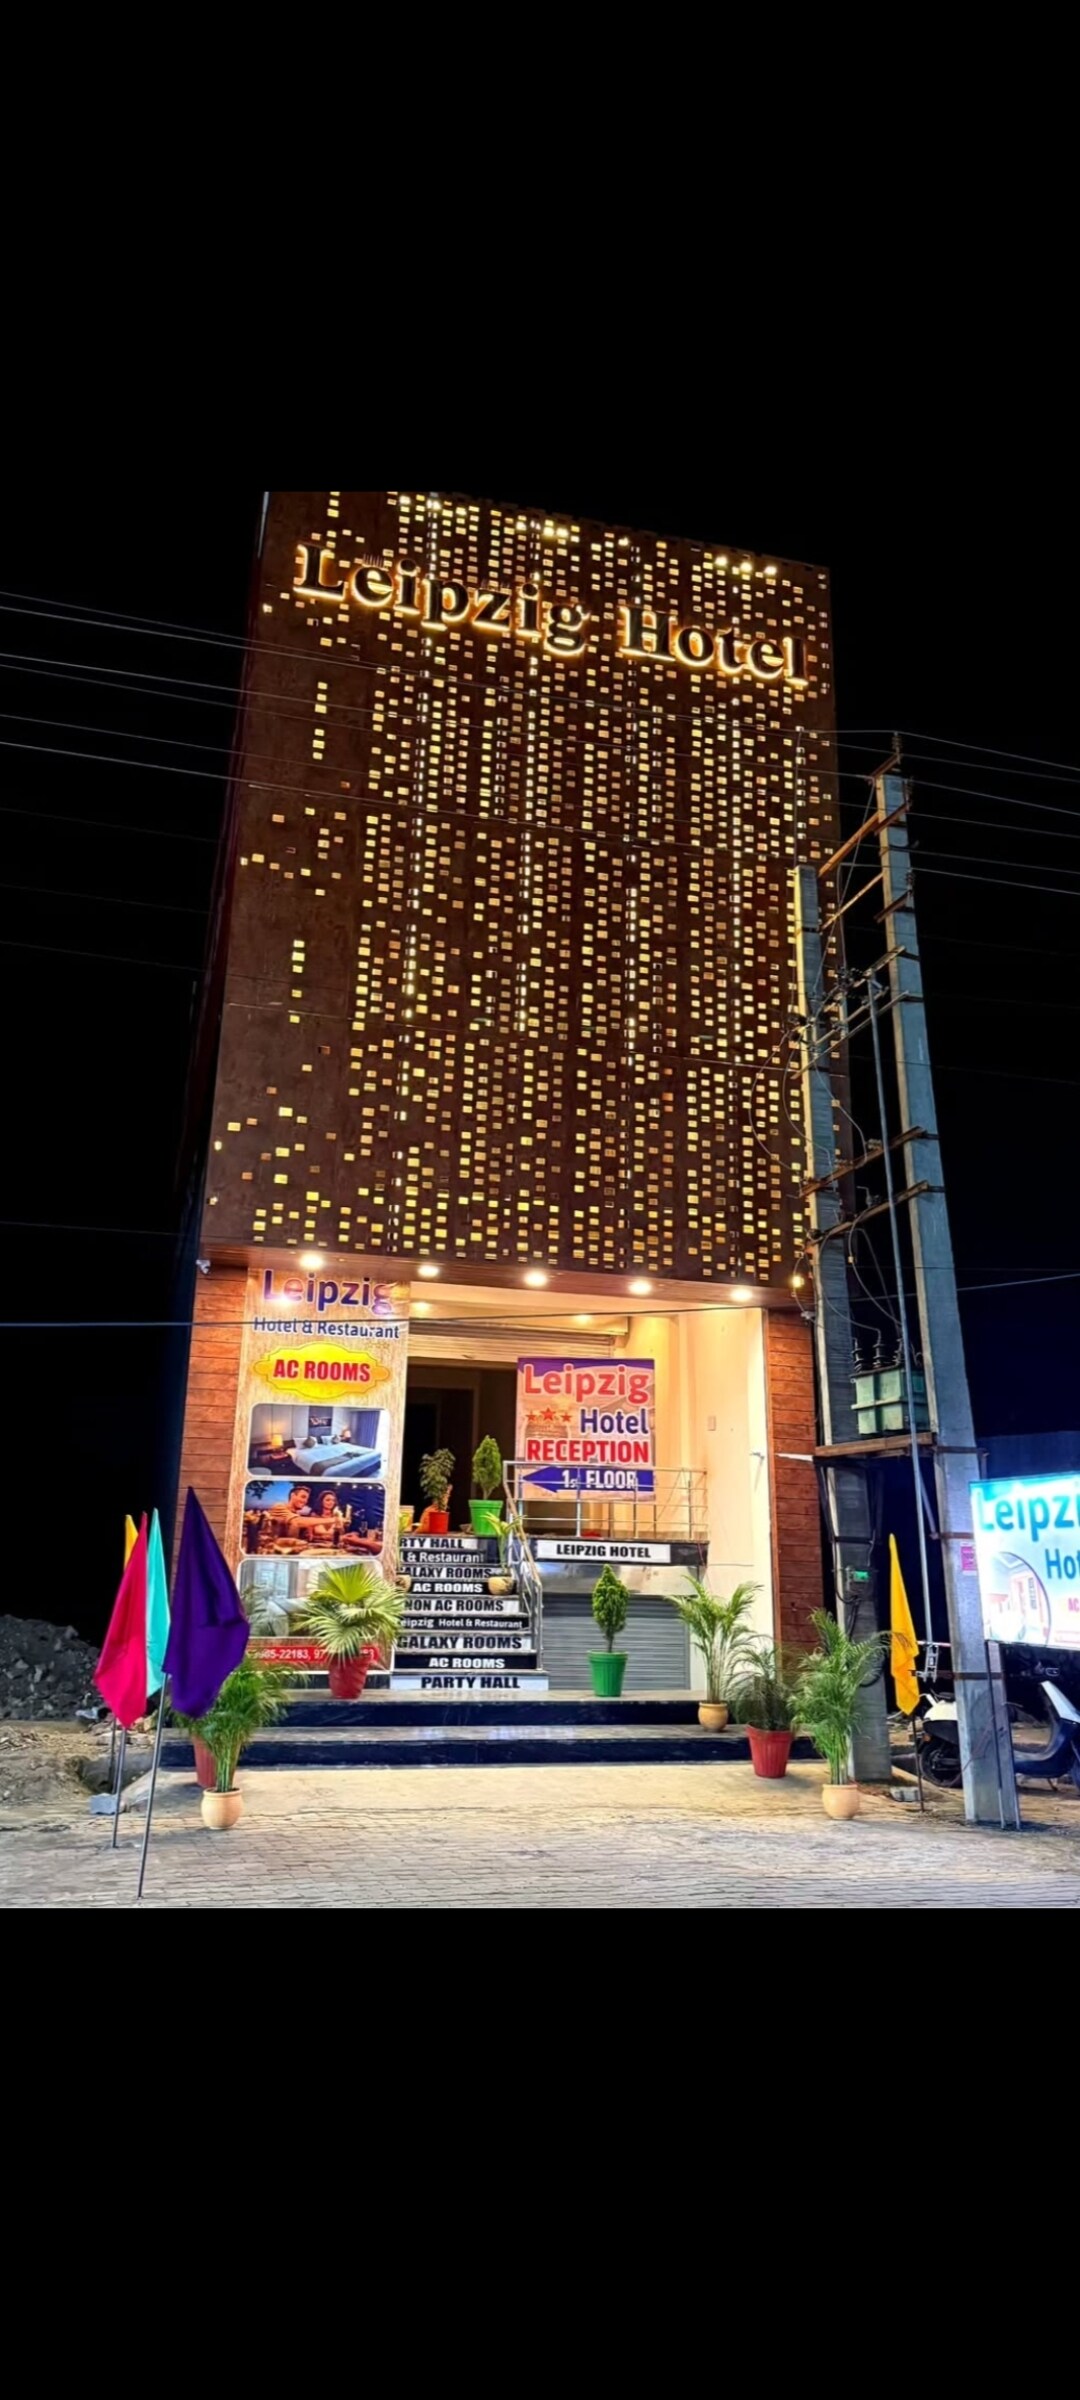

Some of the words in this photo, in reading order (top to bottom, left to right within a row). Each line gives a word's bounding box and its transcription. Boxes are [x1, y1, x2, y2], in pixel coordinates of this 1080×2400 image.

[293, 542, 589, 656] Leipzig
[619, 603, 808, 686] Hotel
[263, 1269, 394, 1315] Leipzig
[253, 1317, 297, 1333] Hotel
[302, 1319, 313, 1334] &
[317, 1321, 400, 1339] Restaurant
[273, 1359, 299, 1378] AC
[304, 1361, 371, 1382] ROOMS
[523, 1364, 650, 1405] Leipzig
[580, 1408, 649, 1434] Hotel
[527, 1439, 649, 1463] RECEPTION
[586, 1470, 638, 1489] FLOOR
[400, 1537, 425, 1549] RTY
[430, 1538, 464, 1549] HALL
[407, 1551, 417, 1562] &
[420, 1551, 484, 1563] Restaurant
[556, 1543, 606, 1557] LEIPZIG
[610, 1545, 651, 1558] HOTEL
[446, 1568, 492, 1578] ROOMS
[412, 1583, 431, 1593] AC
[434, 1583, 483, 1593] ROOMS
[404, 1600, 432, 1611] NON
[434, 1600, 453, 1611] AC
[456, 1600, 504, 1611] ROOMS
[438, 1618, 464, 1627] Hotel
[475, 1619, 522, 1628] Restaurant
[397, 1636, 460, 1649] GALAXY
[463, 1636, 522, 1649] ROOMS
[428, 1657, 449, 1668] AC
[452, 1657, 505, 1668] ROOMS
[421, 1677, 476, 1688] PARTY
[481, 1677, 520, 1689] HALL
